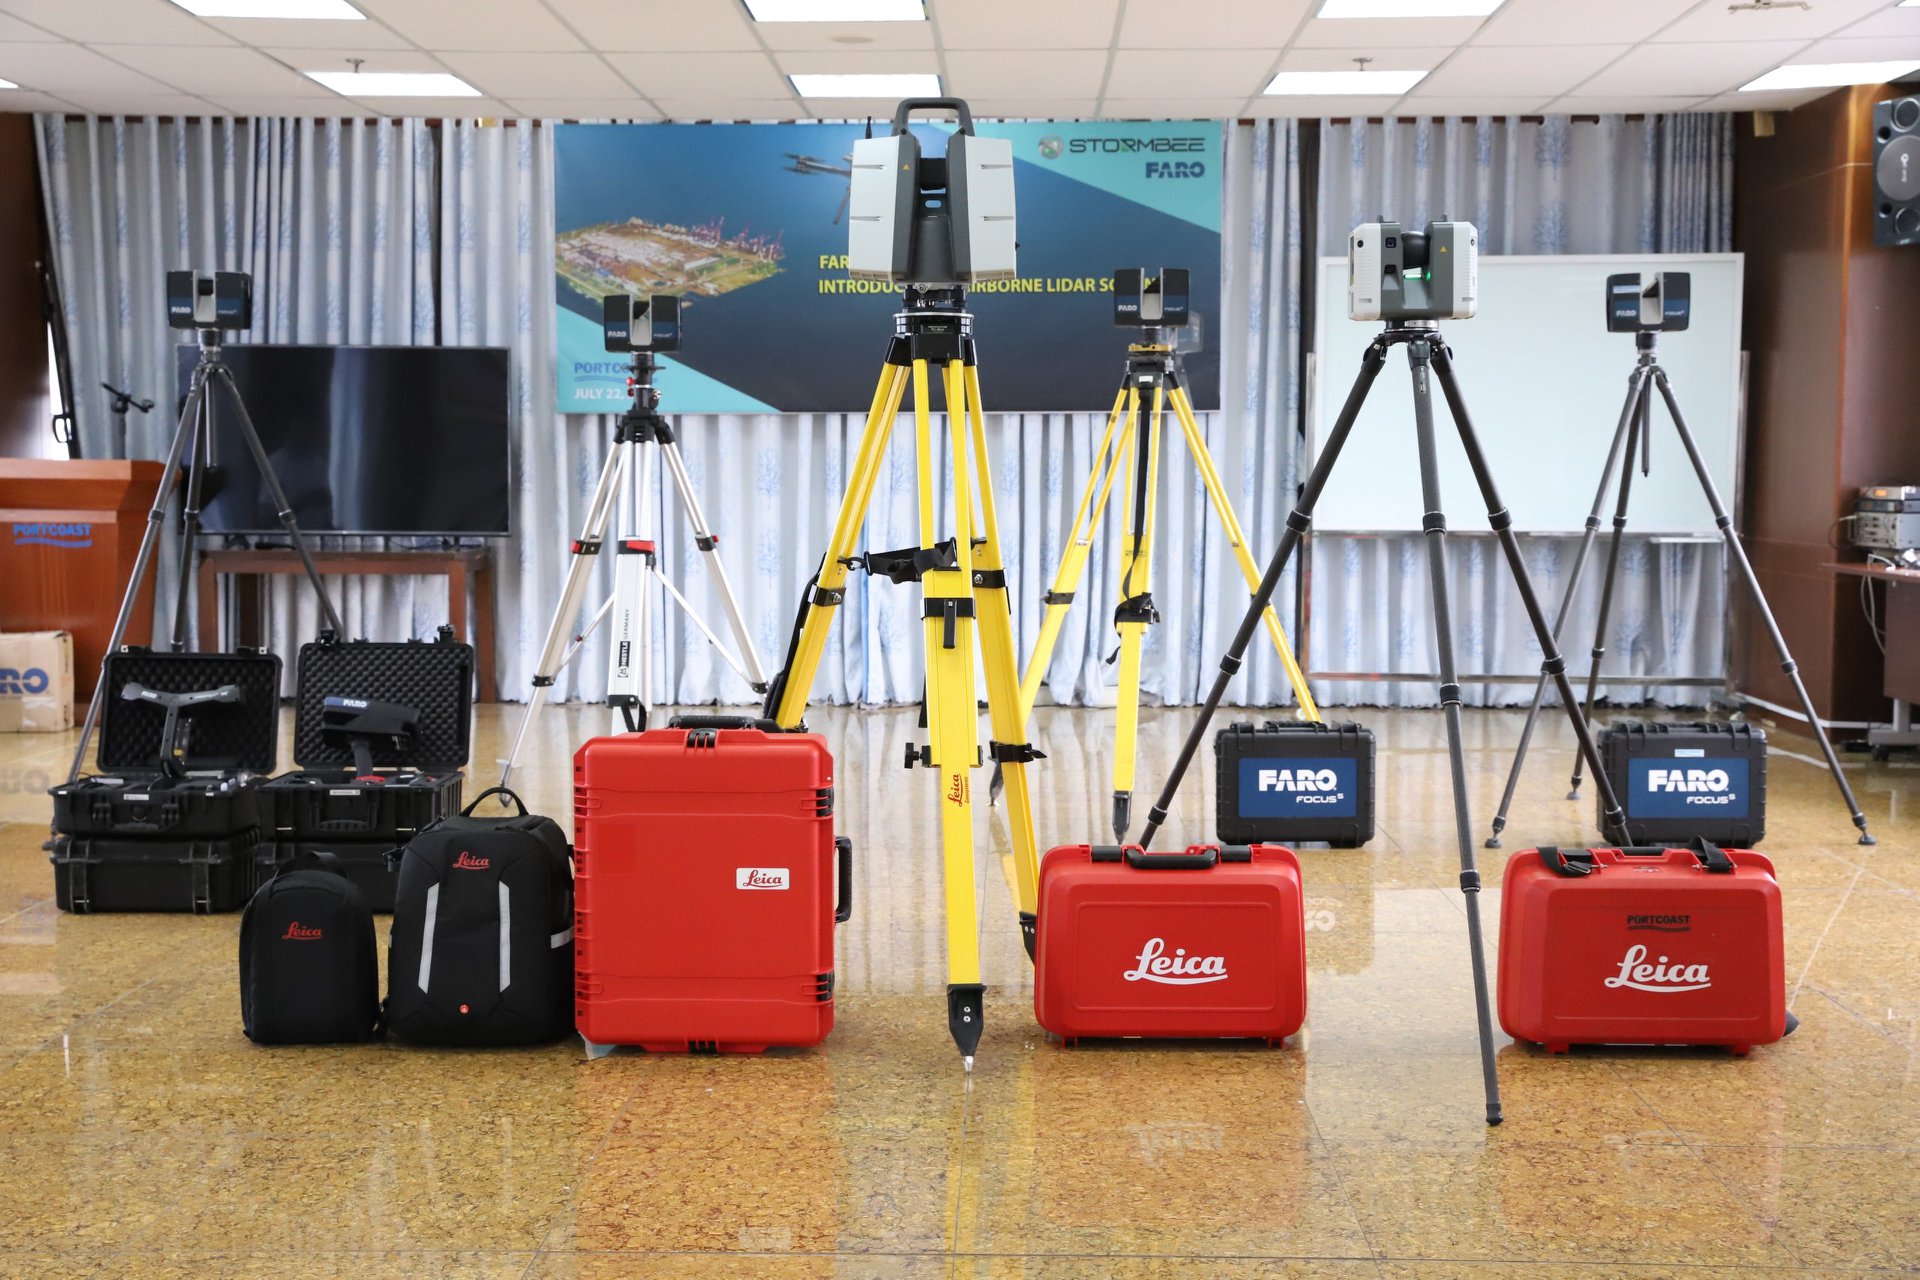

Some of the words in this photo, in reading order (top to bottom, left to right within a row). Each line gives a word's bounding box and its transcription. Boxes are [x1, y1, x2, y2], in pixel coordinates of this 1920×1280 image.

[1069, 138, 1205, 153] STORMBEE
[1145, 162, 1206, 178] FARO
[819, 255, 849, 269] FAR
[819, 279, 907, 294] INTRODUC
[967, 278, 1042, 293] IRBORNE
[1046, 278, 1096, 293] LIDAR
[573, 388, 602, 400] JULY
[13, 523, 92, 537] PORTCOAST
[0, 668, 49, 694] RO
[343, 699, 367, 708] FARO
[947, 773, 963, 807] Leica
[1258, 769, 1338, 792] FARO
[1648, 769, 1730, 792] FARO
[452, 851, 490, 870] Leica
[743, 869, 783, 888] Leica
[1627, 915, 1691, 925] PORTCOAST
[282, 921, 322, 940] Leica
[1123, 937, 1229, 985] Leica
[1604, 944, 1712, 993] Leica
